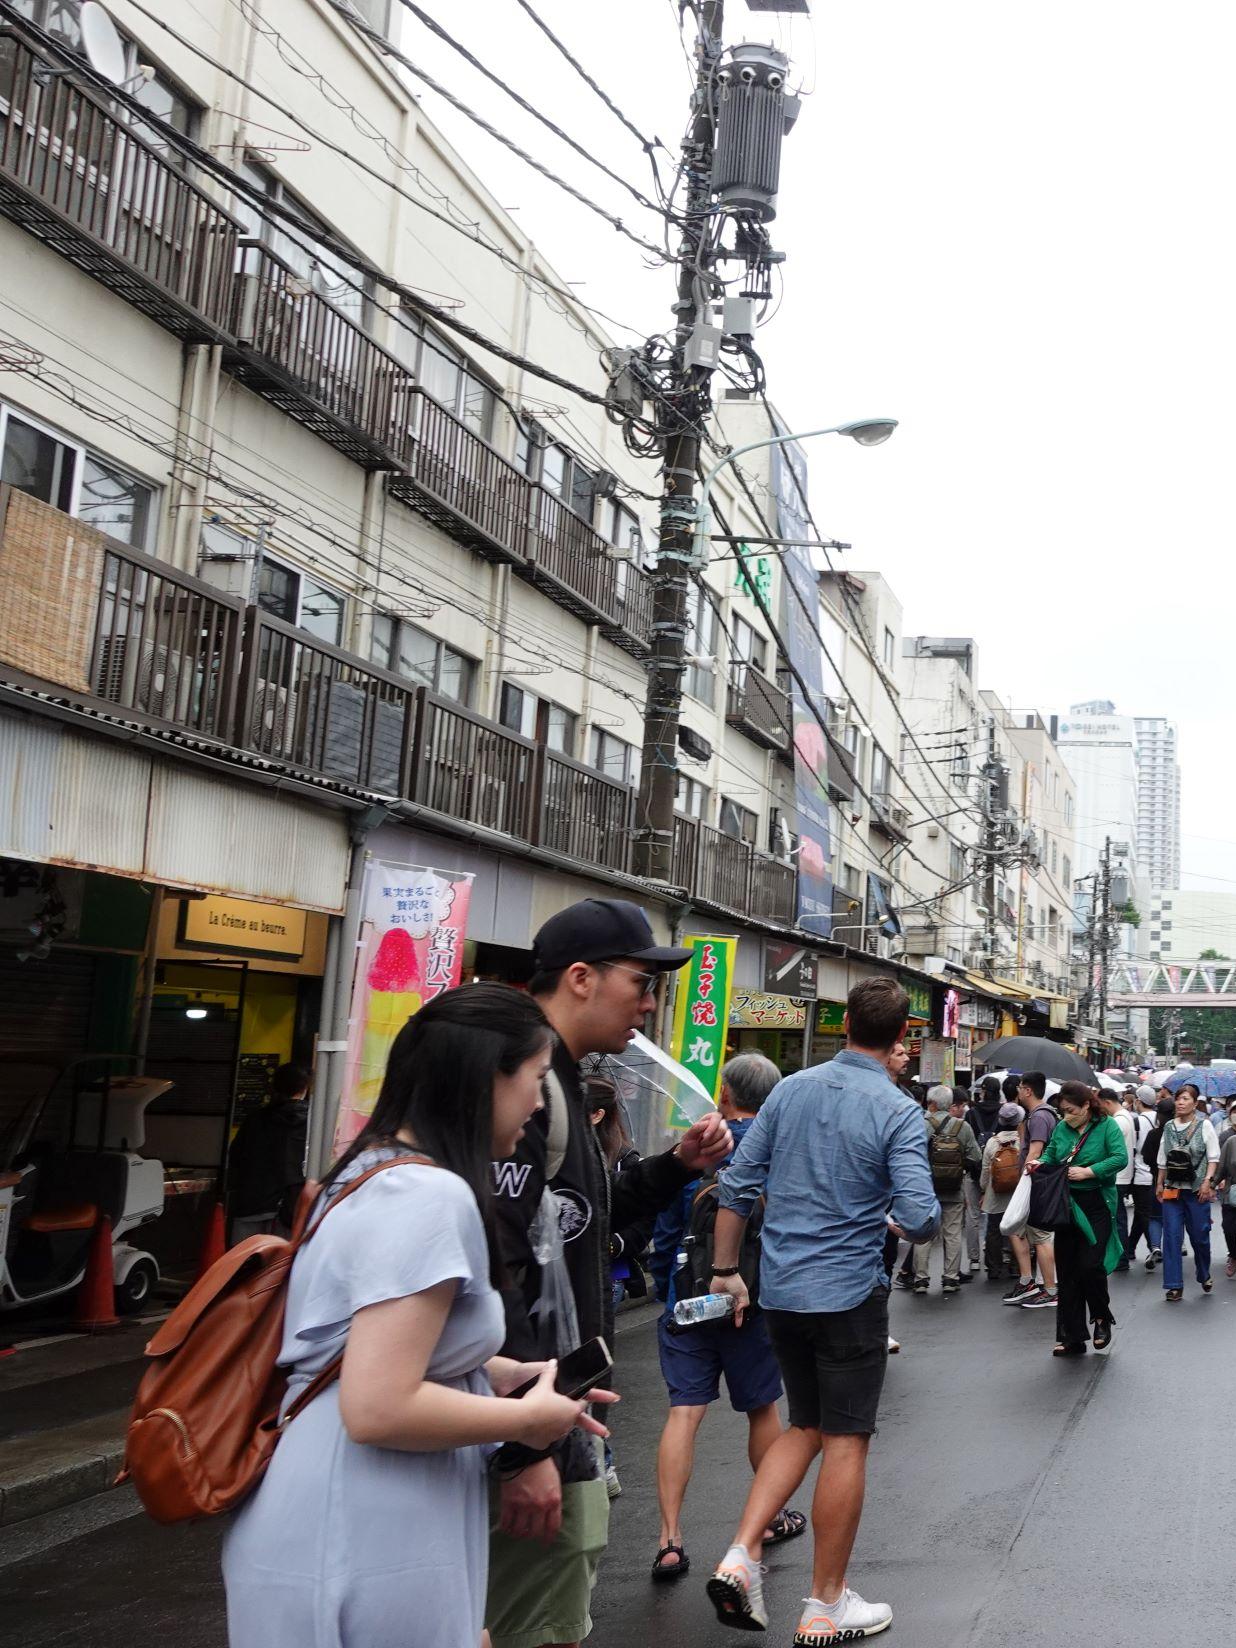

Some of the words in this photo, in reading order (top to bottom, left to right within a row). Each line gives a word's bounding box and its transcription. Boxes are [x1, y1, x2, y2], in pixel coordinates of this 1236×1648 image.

[208, 911, 217, 925] La
[249, 921, 258, 932] au
[735, 994, 788, 1011] フィッシュ
[751, 1009, 806, 1026] マーケット
[685, 1036, 715, 1067] 丸
